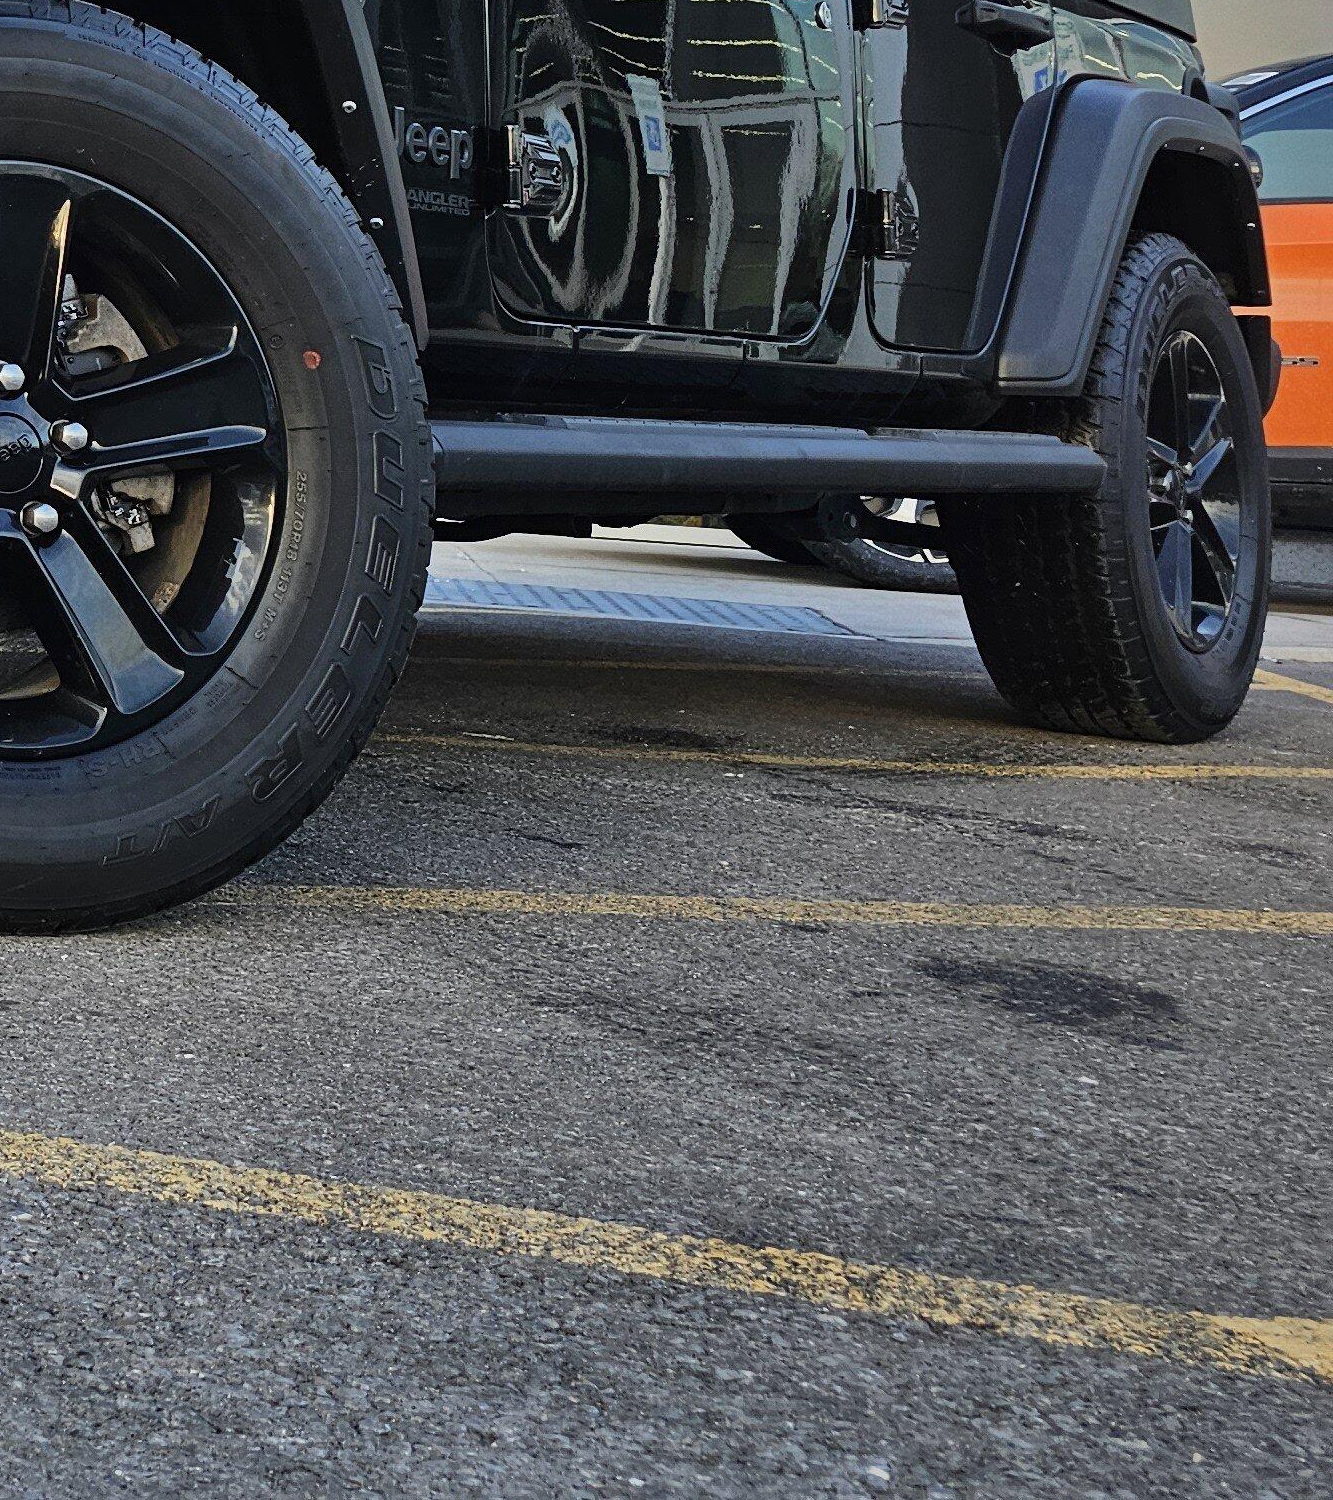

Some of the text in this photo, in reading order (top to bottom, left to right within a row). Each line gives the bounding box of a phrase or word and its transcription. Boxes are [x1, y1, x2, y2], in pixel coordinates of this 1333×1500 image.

[394, 105, 474, 179] Jeep
[286, 469, 308, 561] 255/70R18
[244, 334, 406, 802] DUELER
